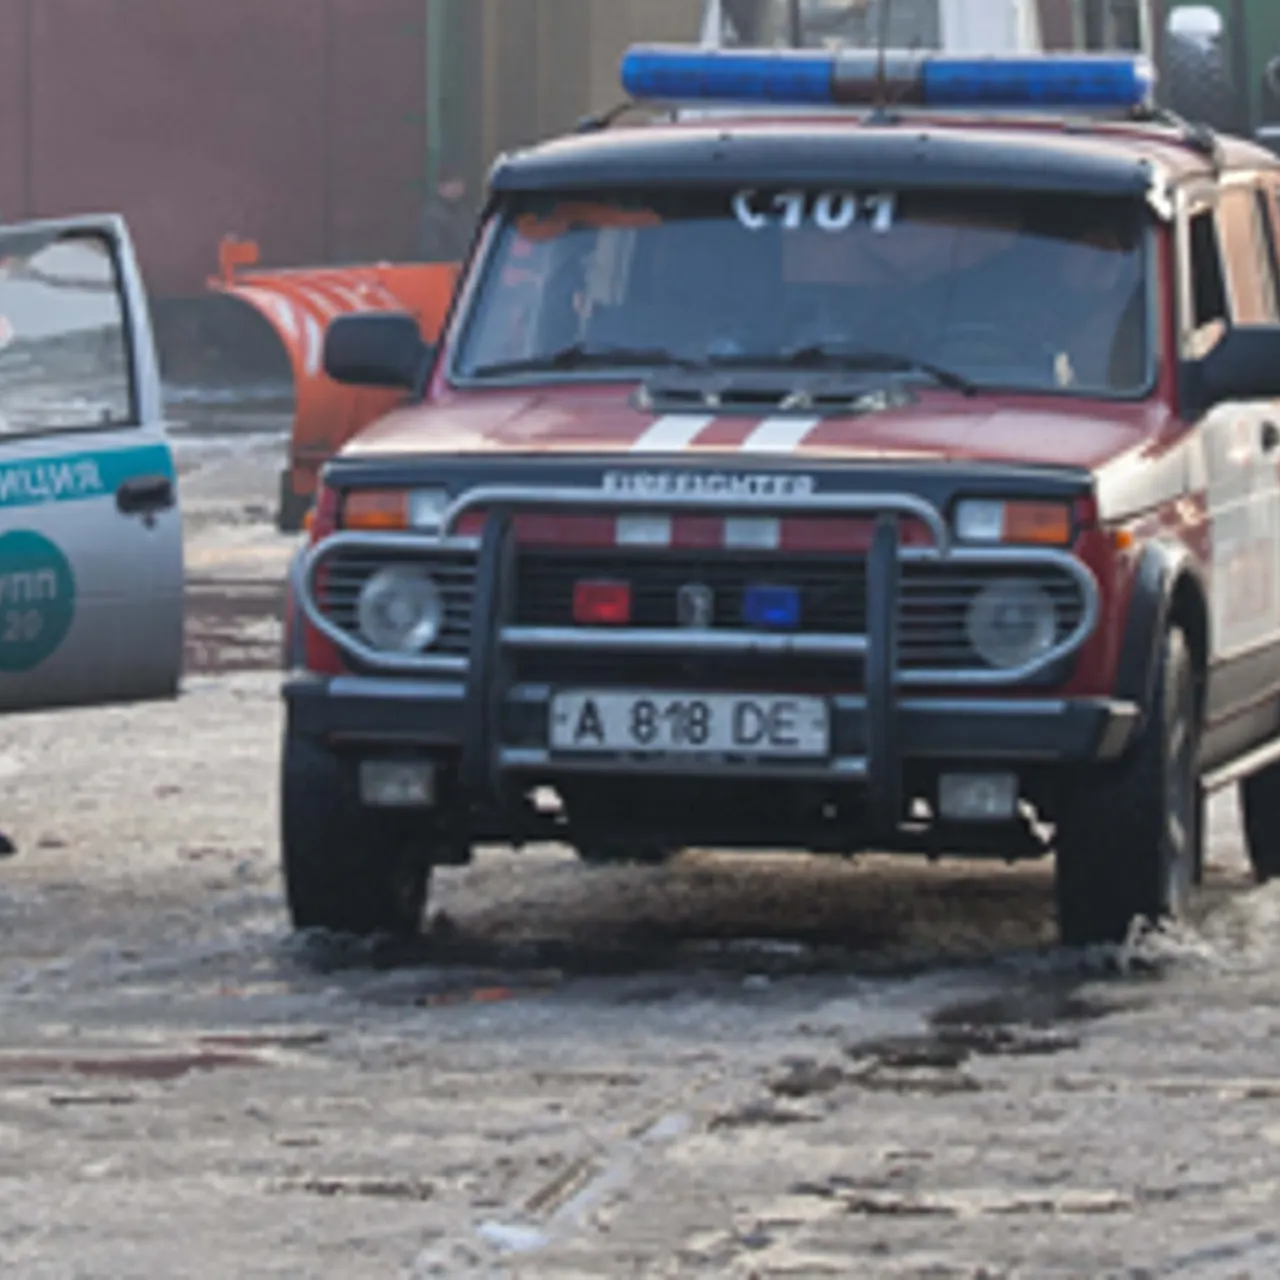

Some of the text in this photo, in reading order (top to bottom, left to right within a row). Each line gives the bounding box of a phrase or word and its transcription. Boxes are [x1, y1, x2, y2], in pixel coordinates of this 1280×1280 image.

[573, 696, 800, 746] A 818 DE
